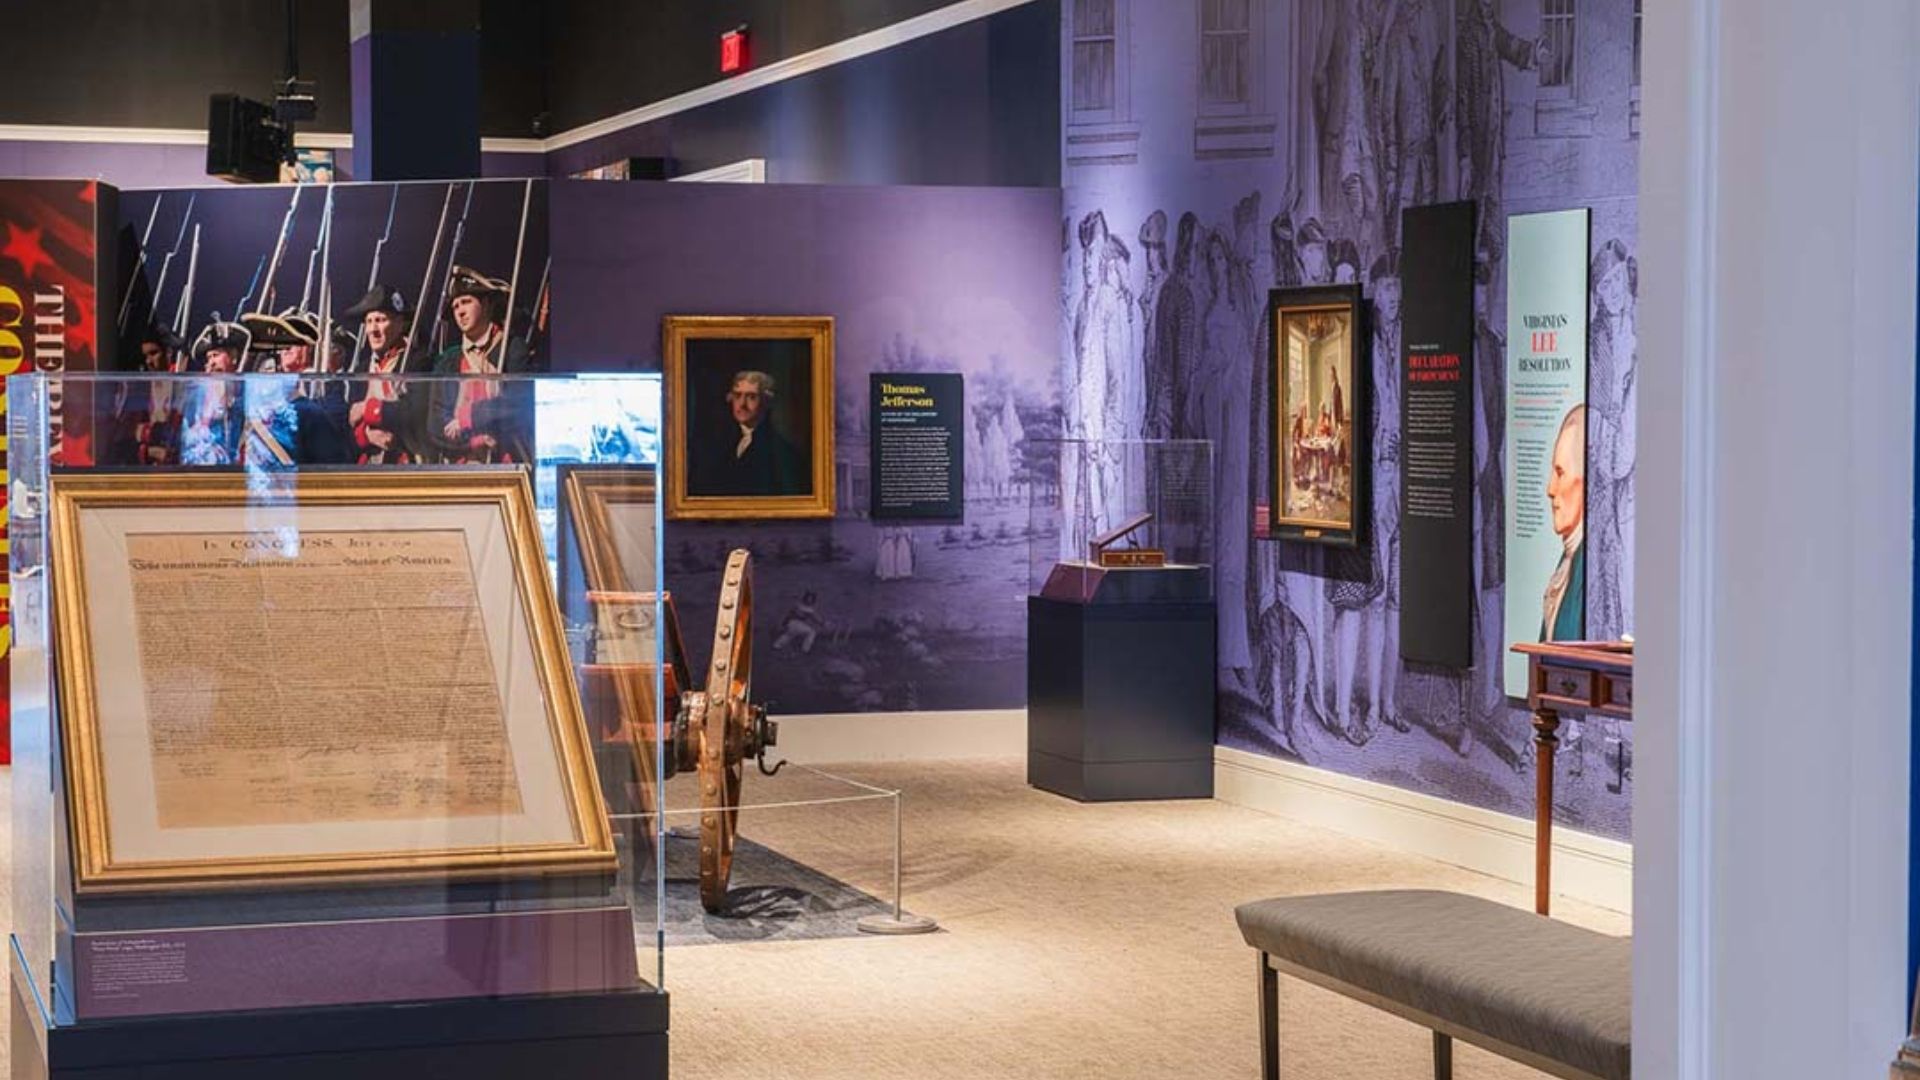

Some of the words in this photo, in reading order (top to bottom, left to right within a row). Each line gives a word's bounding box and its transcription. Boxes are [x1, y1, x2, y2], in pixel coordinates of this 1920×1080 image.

[34, 285, 65, 372] THE
[1531, 332, 1558, 352] LEE
[1518, 357, 1572, 372] RESOLUTION
[881, 383, 925, 394] Thomas
[881, 396, 934, 407] Jefferson
